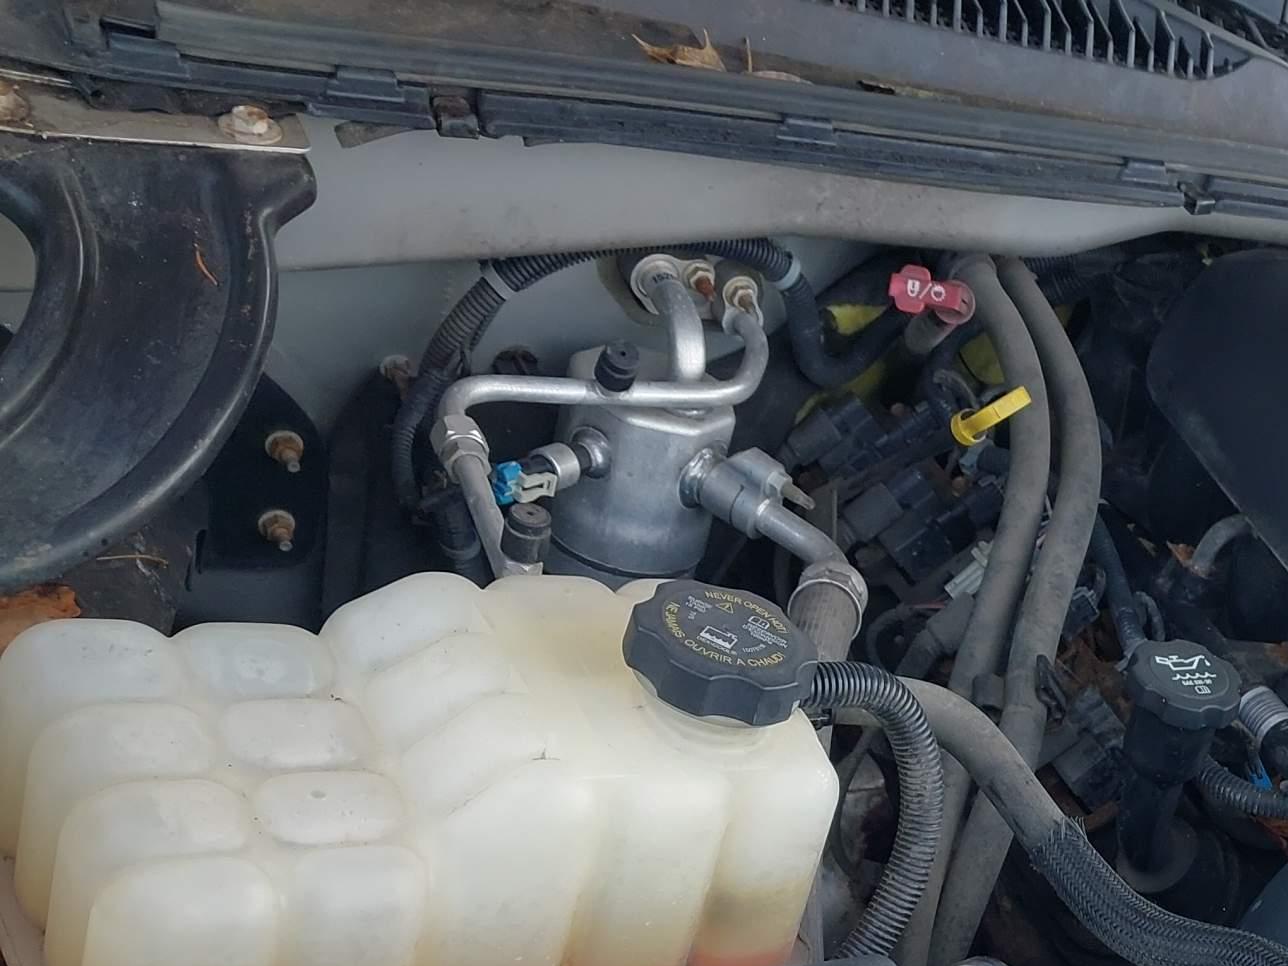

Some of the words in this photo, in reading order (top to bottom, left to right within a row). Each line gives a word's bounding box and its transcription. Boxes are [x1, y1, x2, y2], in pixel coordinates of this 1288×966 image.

[704, 591, 743, 604] NEVER
[742, 599, 770, 618] OPEN
[684, 639, 733, 666] OUVRIR
[735, 657, 747, 667] A
